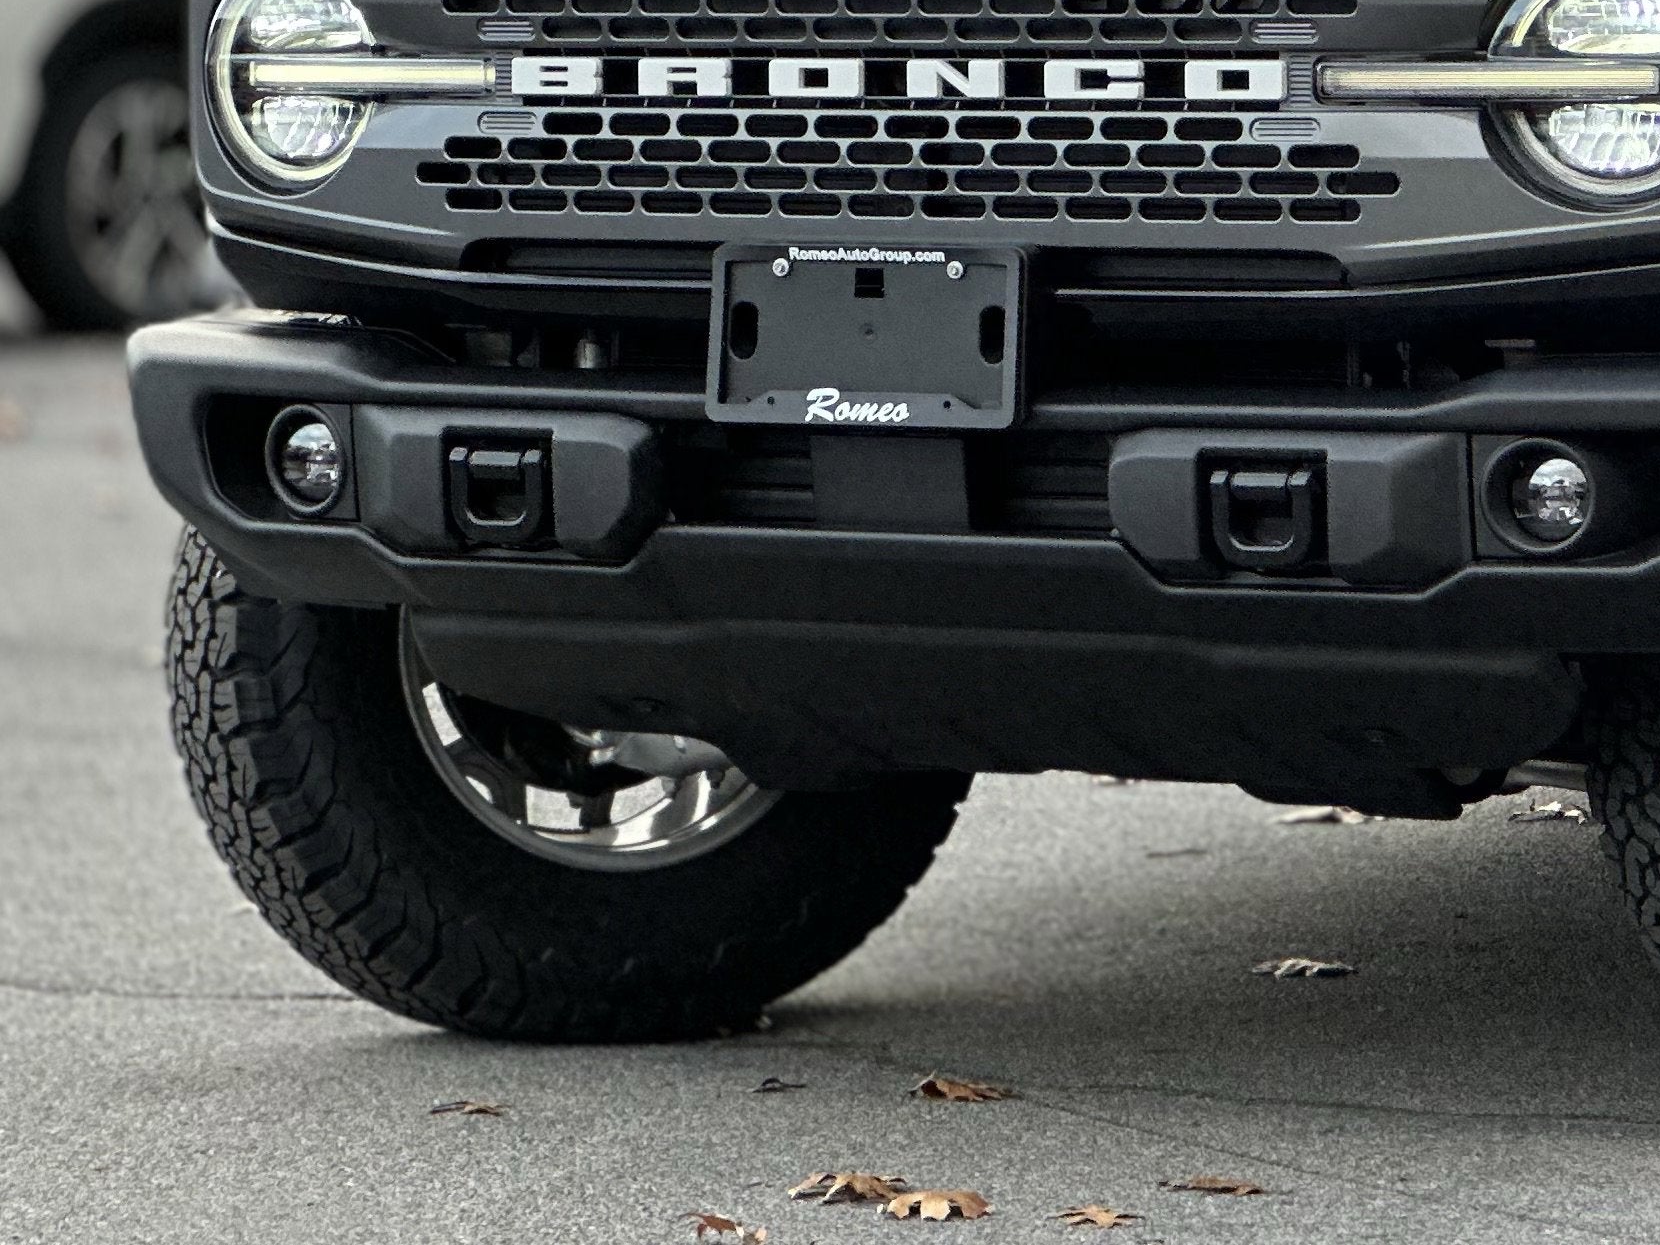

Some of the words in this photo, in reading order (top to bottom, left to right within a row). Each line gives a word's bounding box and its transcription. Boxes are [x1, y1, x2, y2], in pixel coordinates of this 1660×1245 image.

[511, 56, 1287, 101] BRONCO
[788, 247, 945, 264] RomeoAutoGroup.com
[805, 388, 910, 423] Romeo
